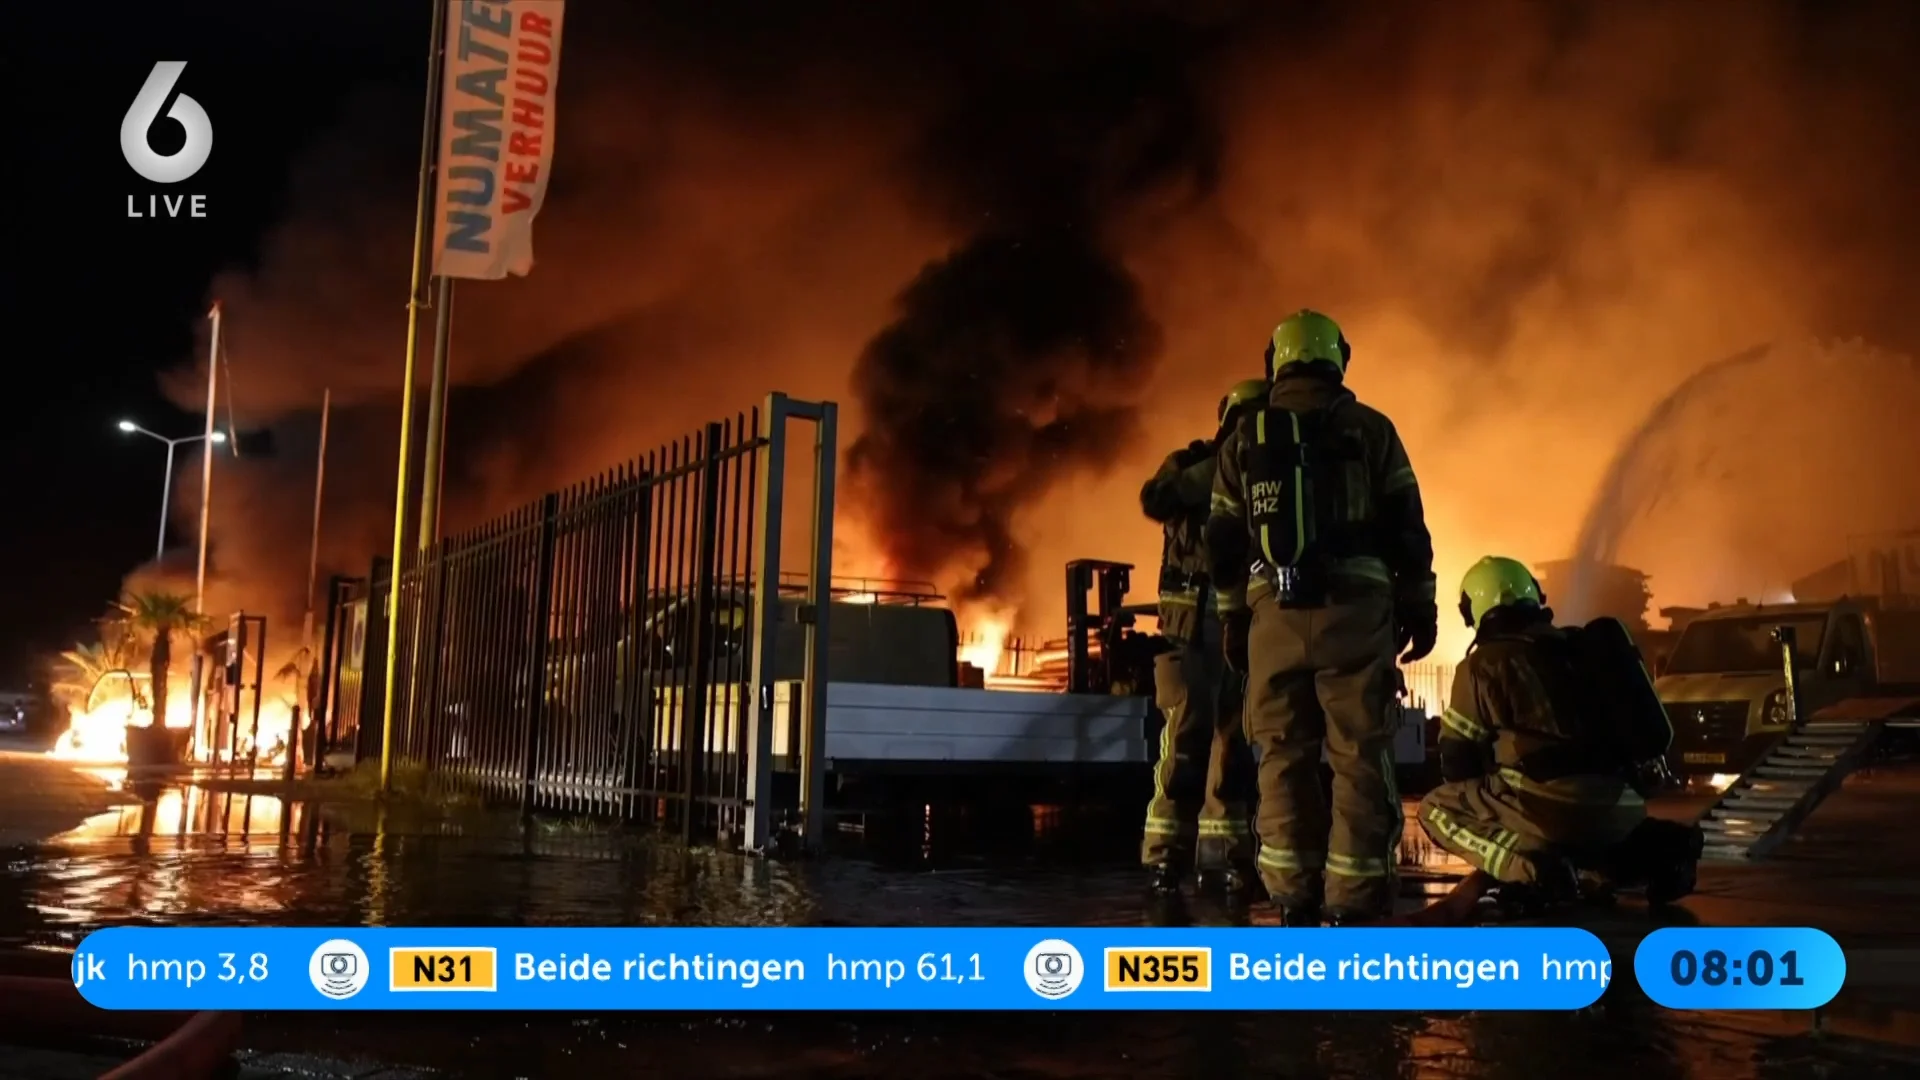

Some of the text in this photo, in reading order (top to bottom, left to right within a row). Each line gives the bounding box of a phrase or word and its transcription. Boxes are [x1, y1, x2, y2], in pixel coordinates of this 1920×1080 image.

[444, 0, 512, 254] NUMATE
[501, 10, 552, 215] VERHUUR
[1252, 481, 1282, 500] BRW
[1253, 498, 1279, 516] ZHZ
